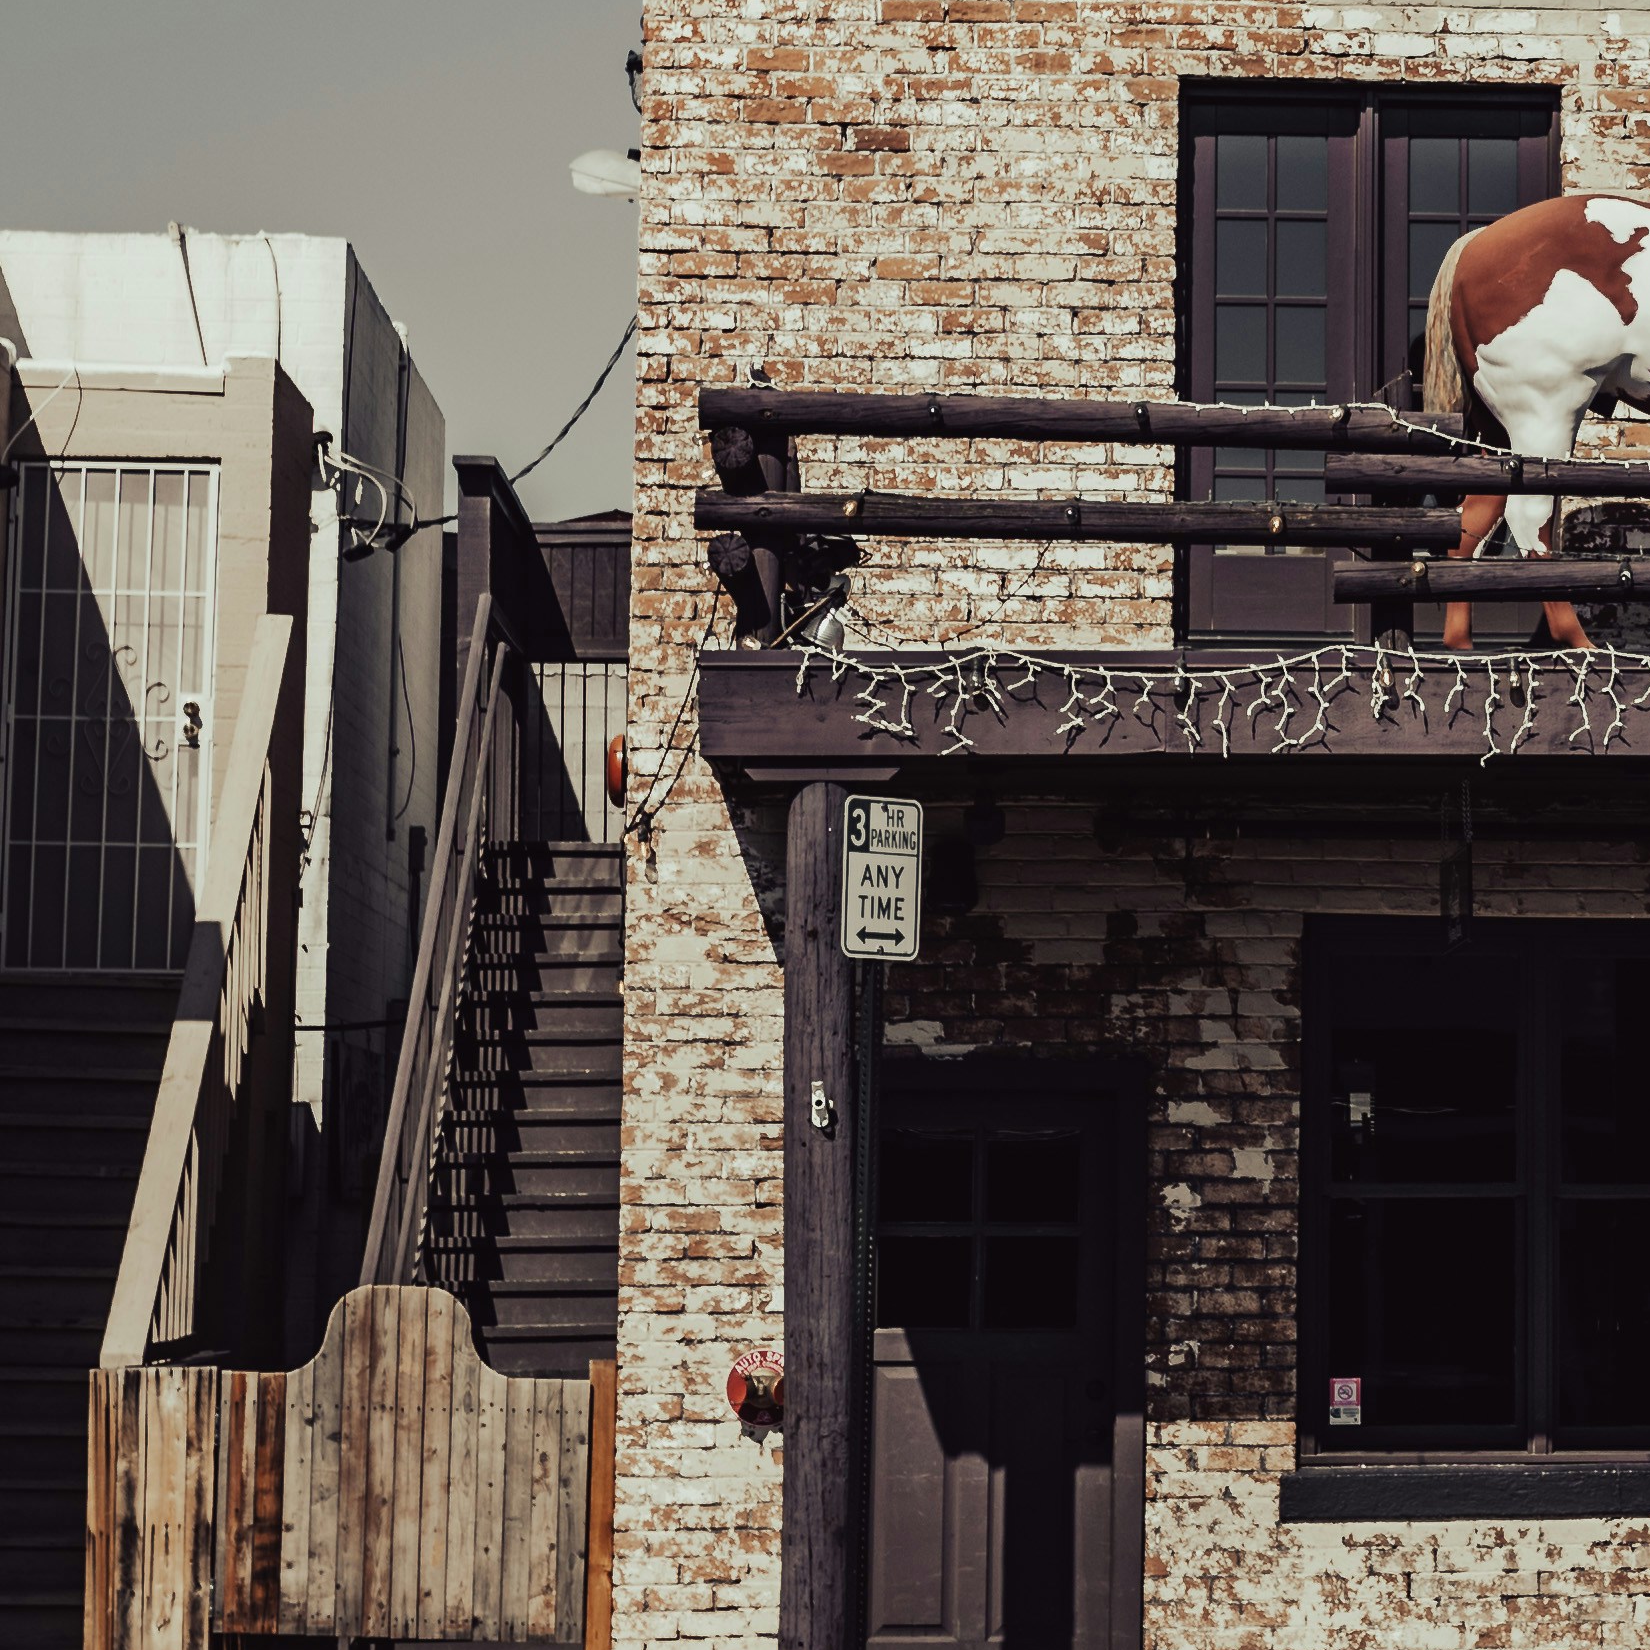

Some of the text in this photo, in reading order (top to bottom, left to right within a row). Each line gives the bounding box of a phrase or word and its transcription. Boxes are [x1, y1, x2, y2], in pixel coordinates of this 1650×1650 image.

[851, 808, 866, 847] 3
[886, 809, 905, 828] HR
[870, 829, 917, 850] PARKING
[860, 864, 905, 889] ANY
[858, 894, 905, 921] TIME
